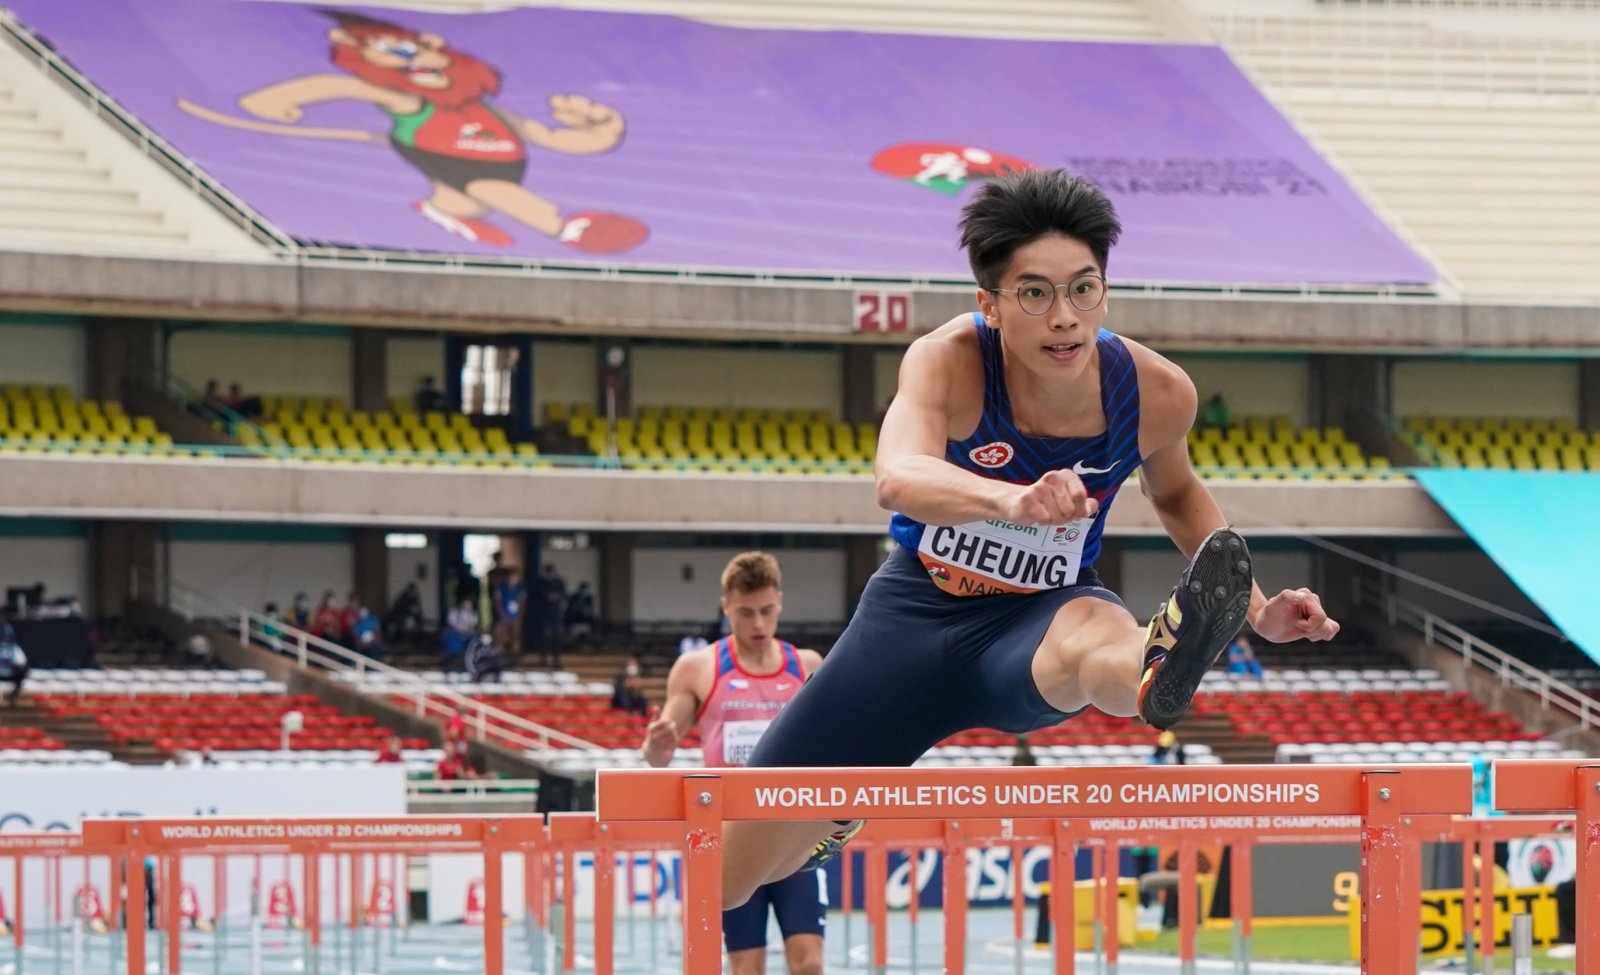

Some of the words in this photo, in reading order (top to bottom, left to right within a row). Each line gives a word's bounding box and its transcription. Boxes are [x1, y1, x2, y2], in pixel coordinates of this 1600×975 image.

[858, 295, 908, 331] 20
[985, 518, 1039, 536] aricom
[930, 526, 1069, 588] CHEUNG
[957, 576, 1016, 596] NAIR
[755, 787, 847, 807] WORLD
[853, 786, 987, 806] ATHLETICS
[994, 785, 1079, 805] UNDER
[1086, 784, 1113, 804] 20
[1120, 783, 1321, 804] CHAMPIONSHIPS
[161, 825, 211, 839] WORLD
[213, 824, 286, 838] ATHLETICS
[287, 824, 336, 837] UNDER
[336, 824, 351, 837] 20
[353, 823, 463, 837] CHAMPIONSHIPS
[1089, 819, 1136, 831] WORLD
[1138, 818, 1208, 831] ATHLETICS
[1210, 817, 1255, 830] UNDER
[1256, 817, 1271, 829] 20
[1272, 816, 1362, 829] CHAMPIONSHI
